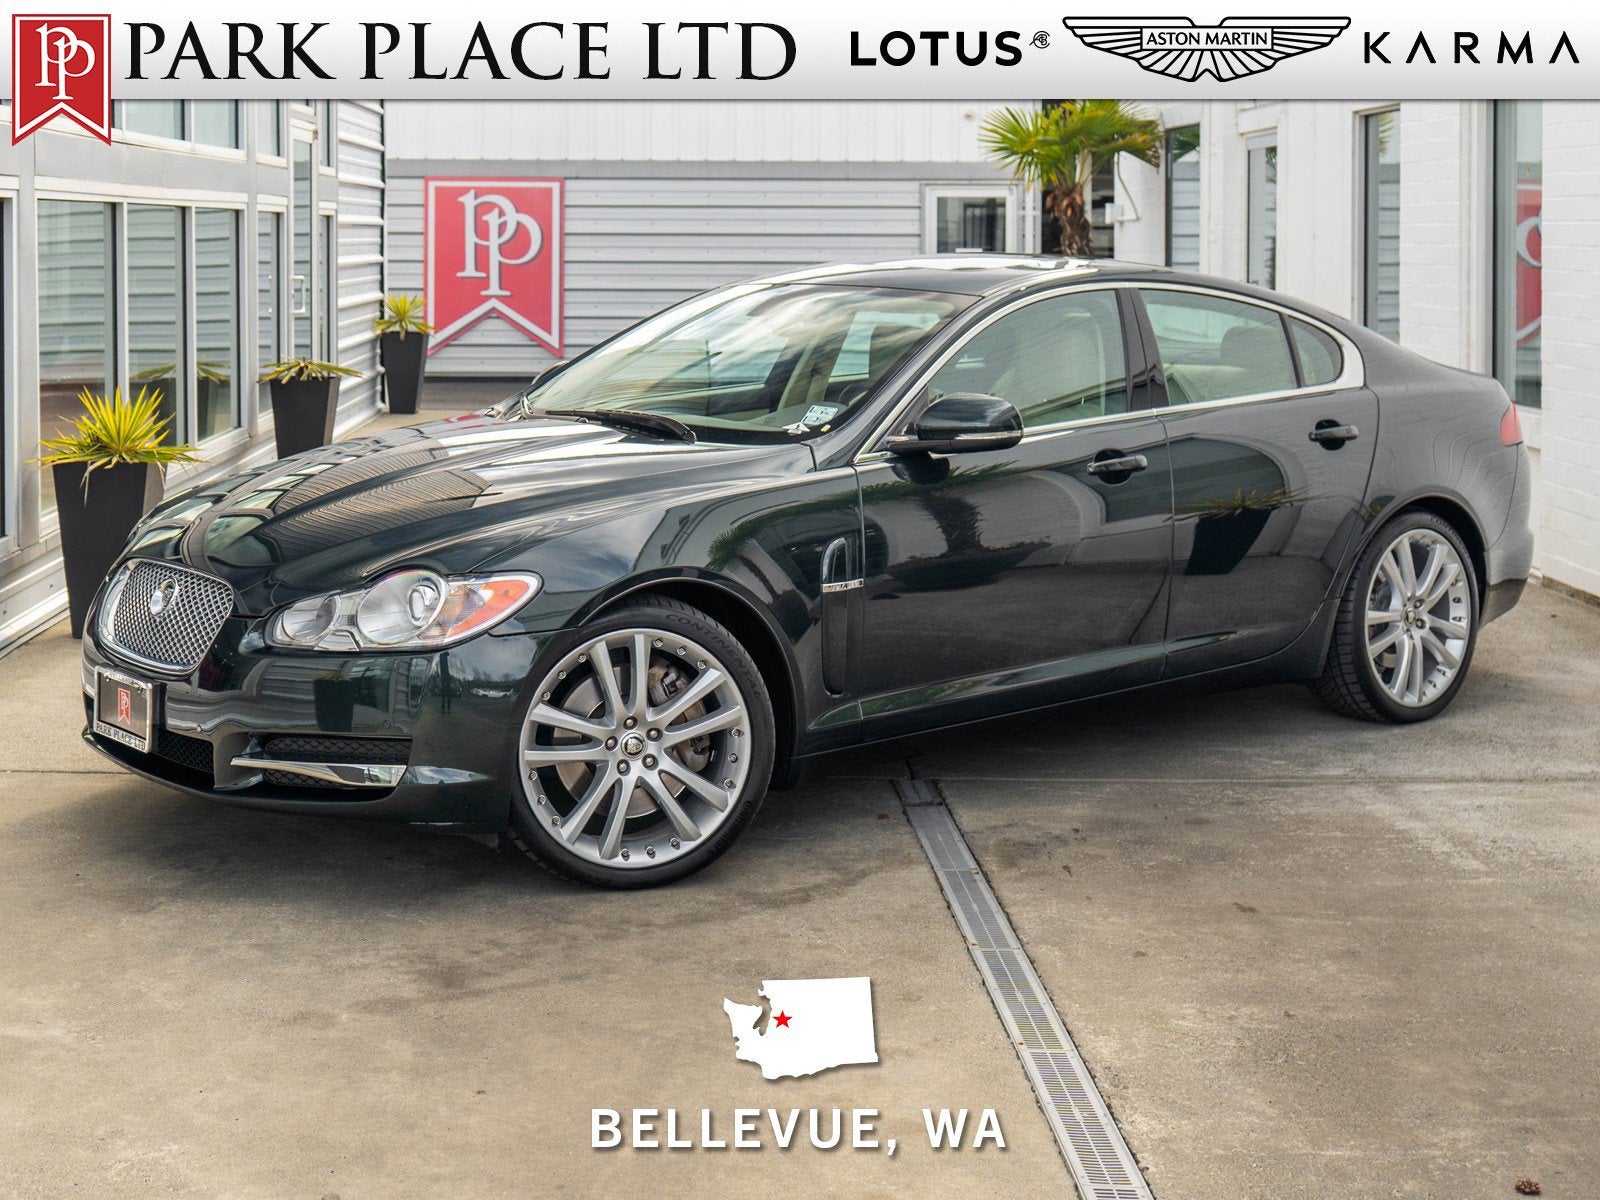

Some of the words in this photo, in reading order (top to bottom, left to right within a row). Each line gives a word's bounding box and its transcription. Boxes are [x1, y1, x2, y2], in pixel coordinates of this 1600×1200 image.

[664, 612, 763, 701] CONTINENTAL
[96, 722, 112, 737] PARK
[113, 728, 133, 746] PLACE
